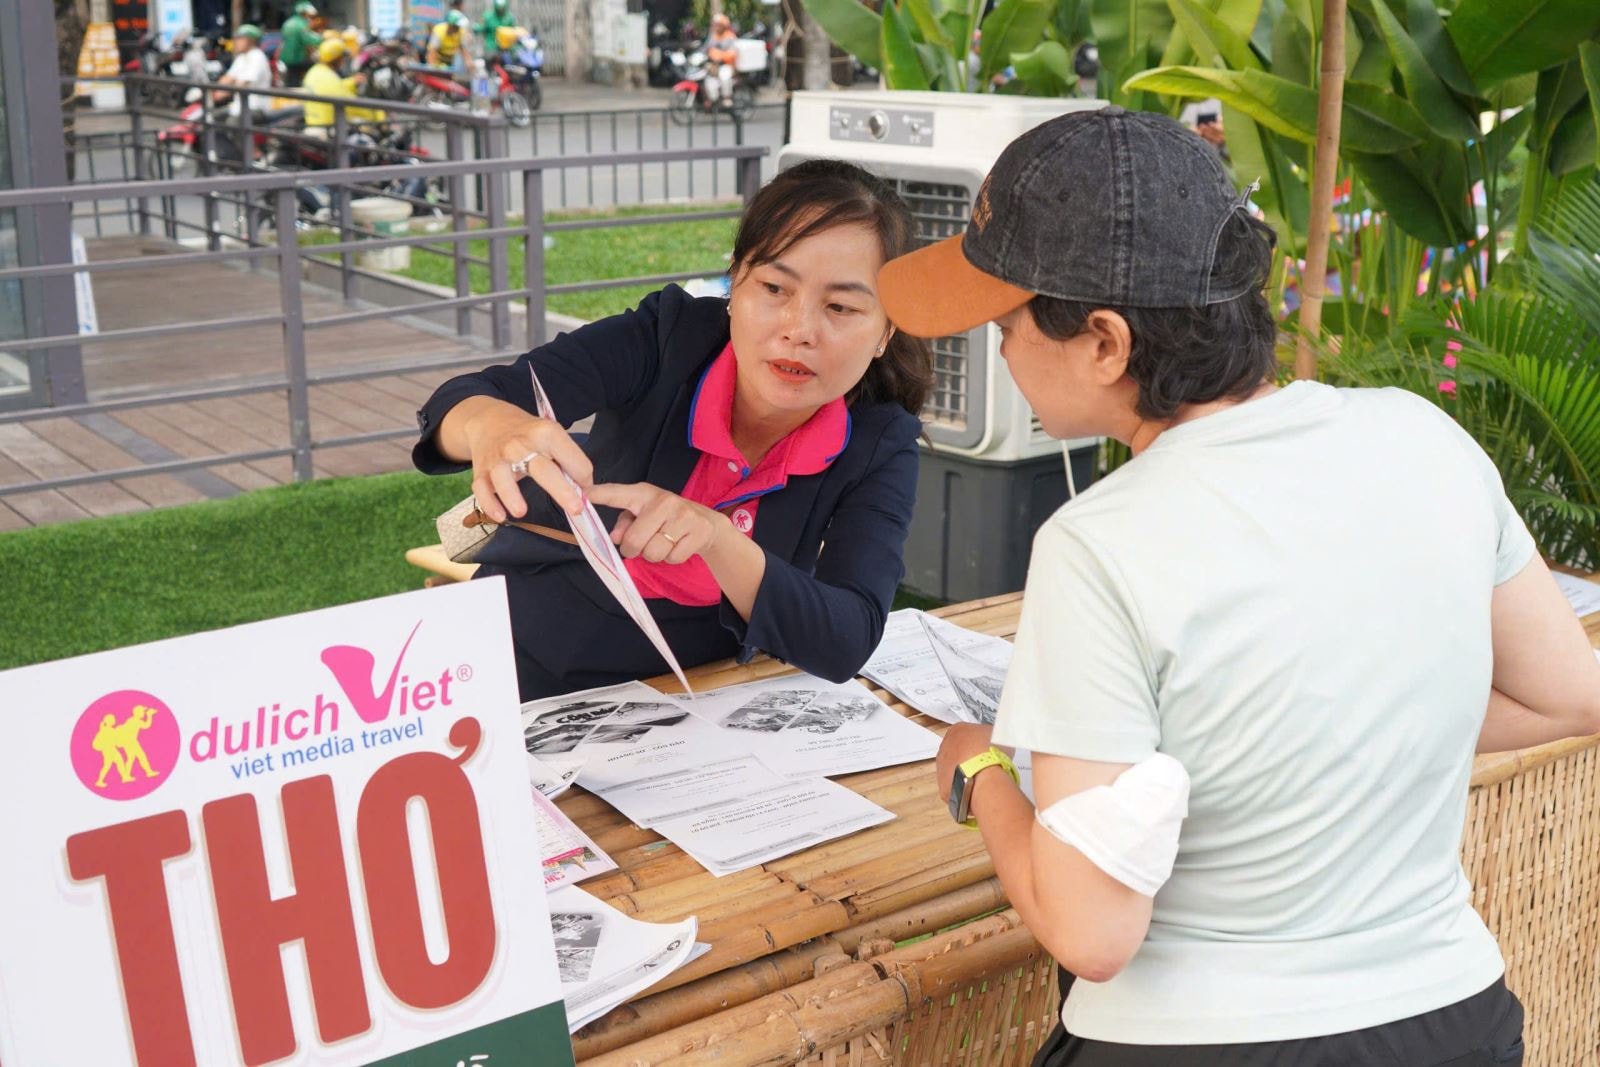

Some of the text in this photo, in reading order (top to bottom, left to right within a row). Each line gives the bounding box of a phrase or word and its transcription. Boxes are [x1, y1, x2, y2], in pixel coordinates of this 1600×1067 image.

[189, 694, 340, 763] dulich
[231, 717, 424, 780] viet media travel
[66, 716, 496, 1067] THƠ
